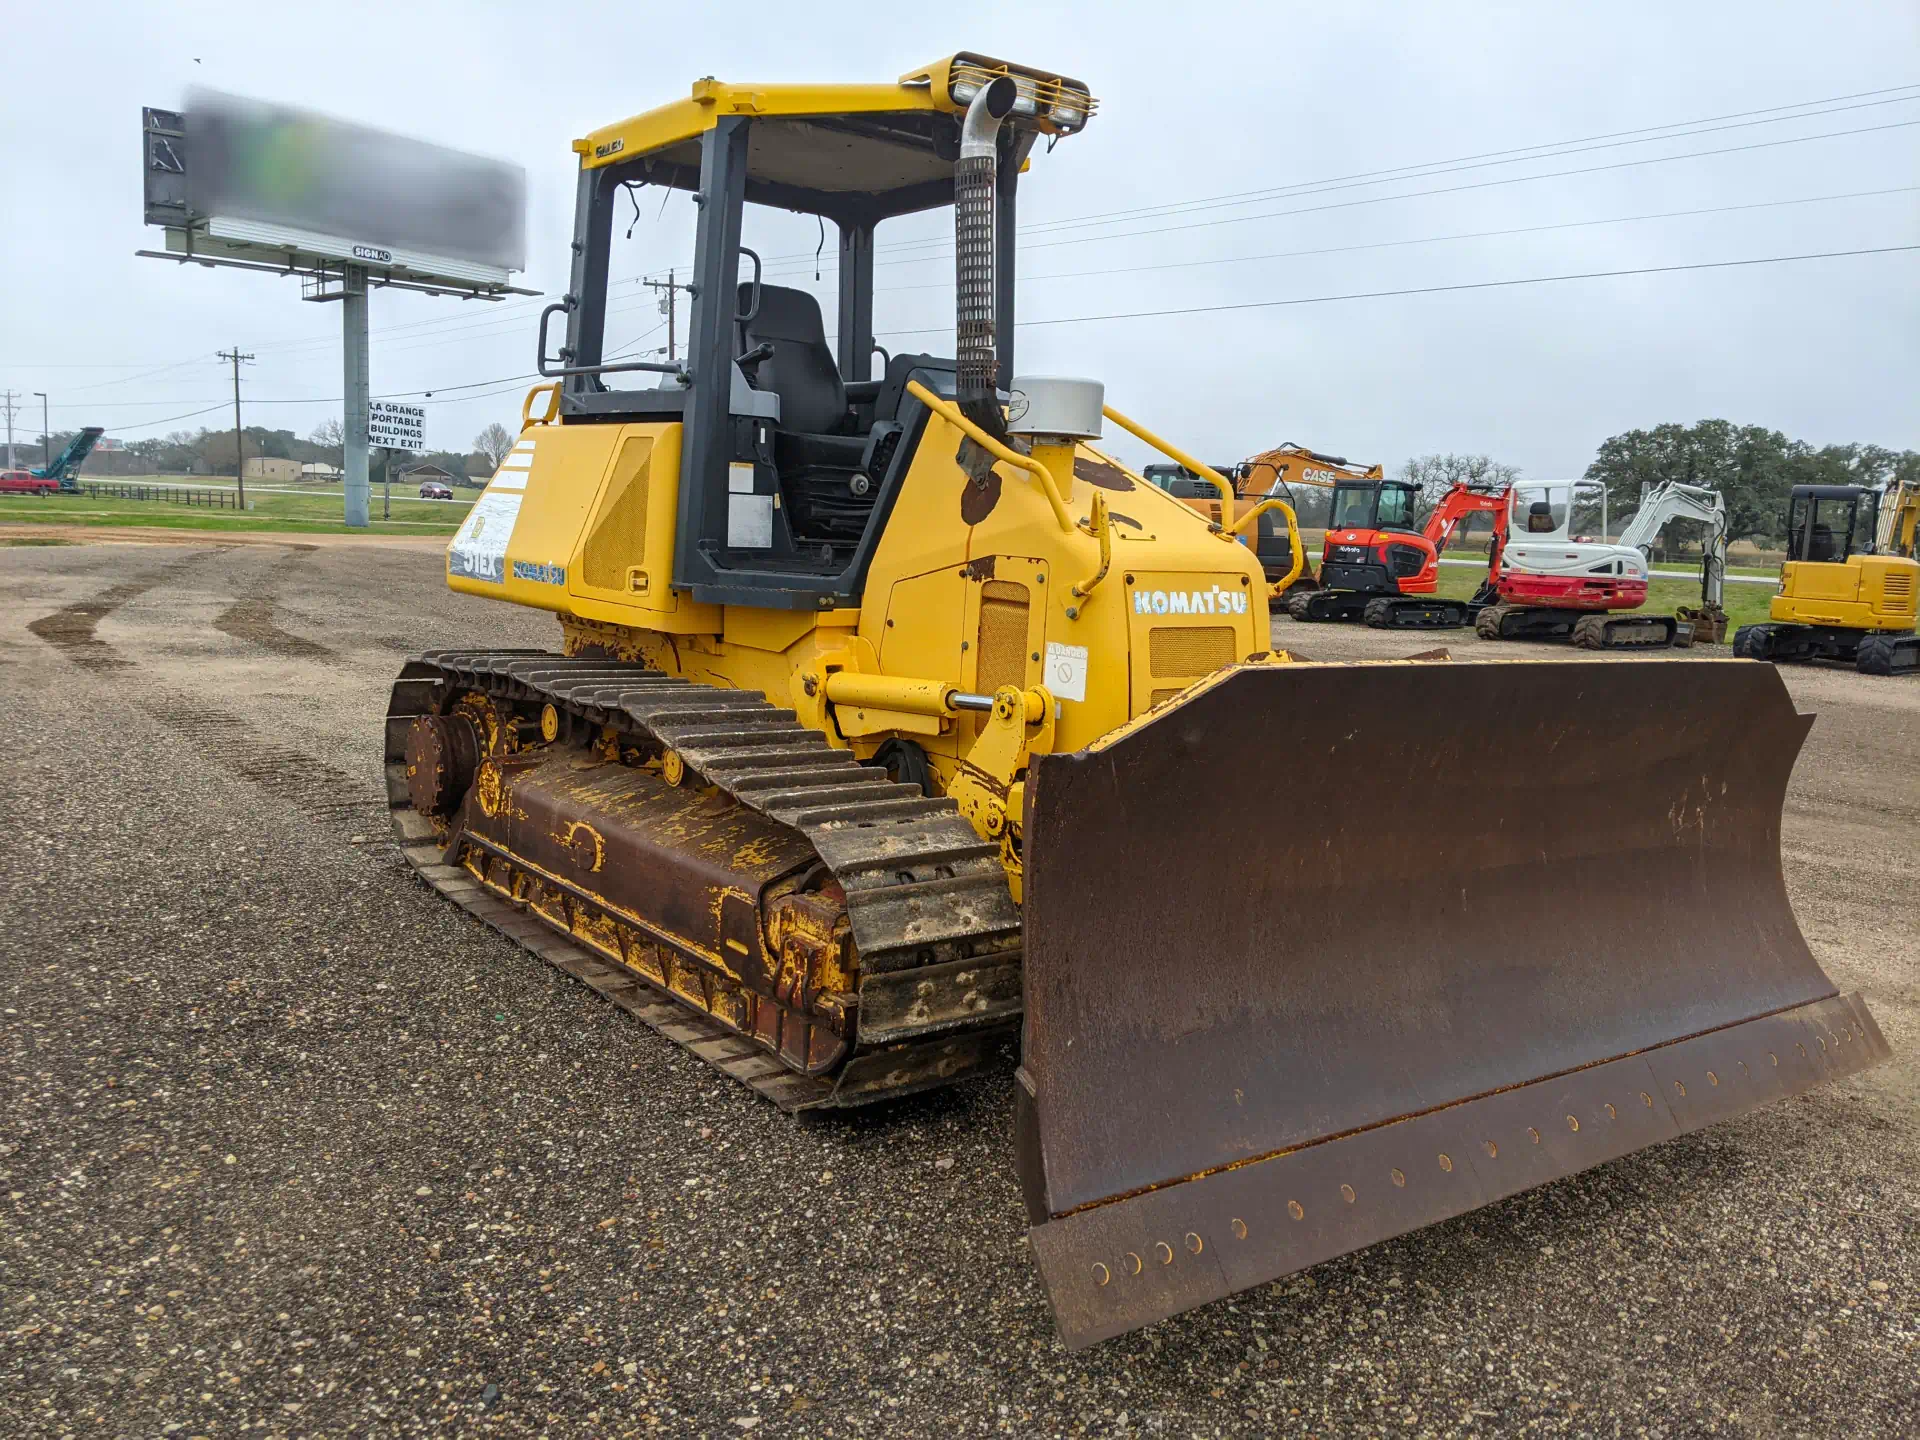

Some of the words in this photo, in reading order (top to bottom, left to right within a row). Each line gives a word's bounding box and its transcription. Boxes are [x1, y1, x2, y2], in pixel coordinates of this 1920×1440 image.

[369, 402, 382, 411] LA
[385, 404, 425, 417] GRANGE
[372, 413, 422, 427] PORTABLE
[371, 424, 422, 438] BUILDINGS
[368, 435, 396, 446] NEXT
[401, 439, 424, 449] EXIT
[1302, 467, 1336, 484] CASE
[1340, 545, 1361, 554] Kubota
[513, 560, 565, 586] KOMATSU
[1133, 584, 1247, 614] KOMATSU
